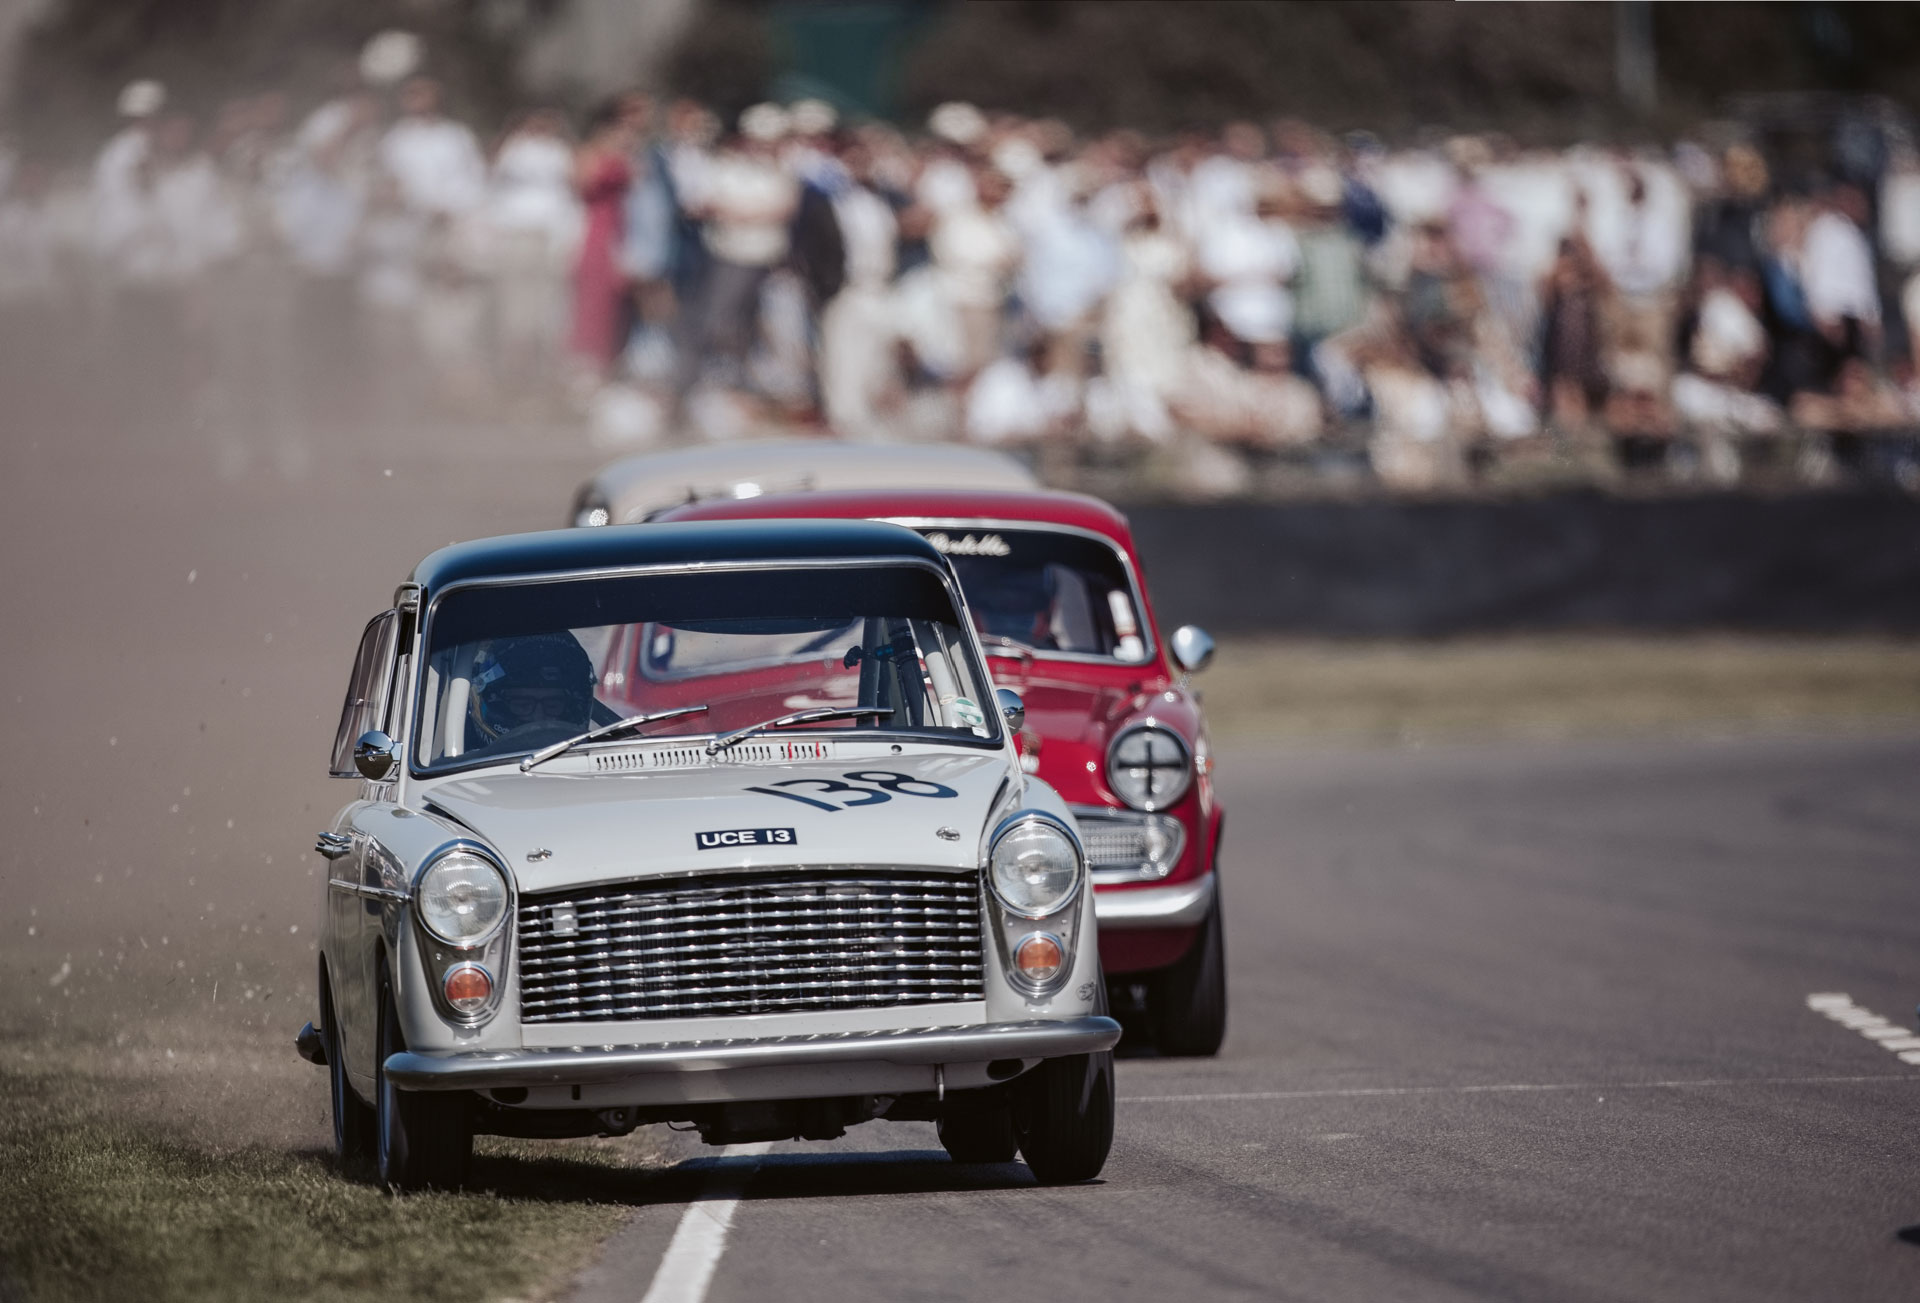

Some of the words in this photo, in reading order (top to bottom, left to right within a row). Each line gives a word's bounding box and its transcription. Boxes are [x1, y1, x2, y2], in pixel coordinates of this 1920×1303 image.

[743, 771, 958, 812] 138
[701, 831, 755, 846] UCE
[766, 830, 790, 842] 13
